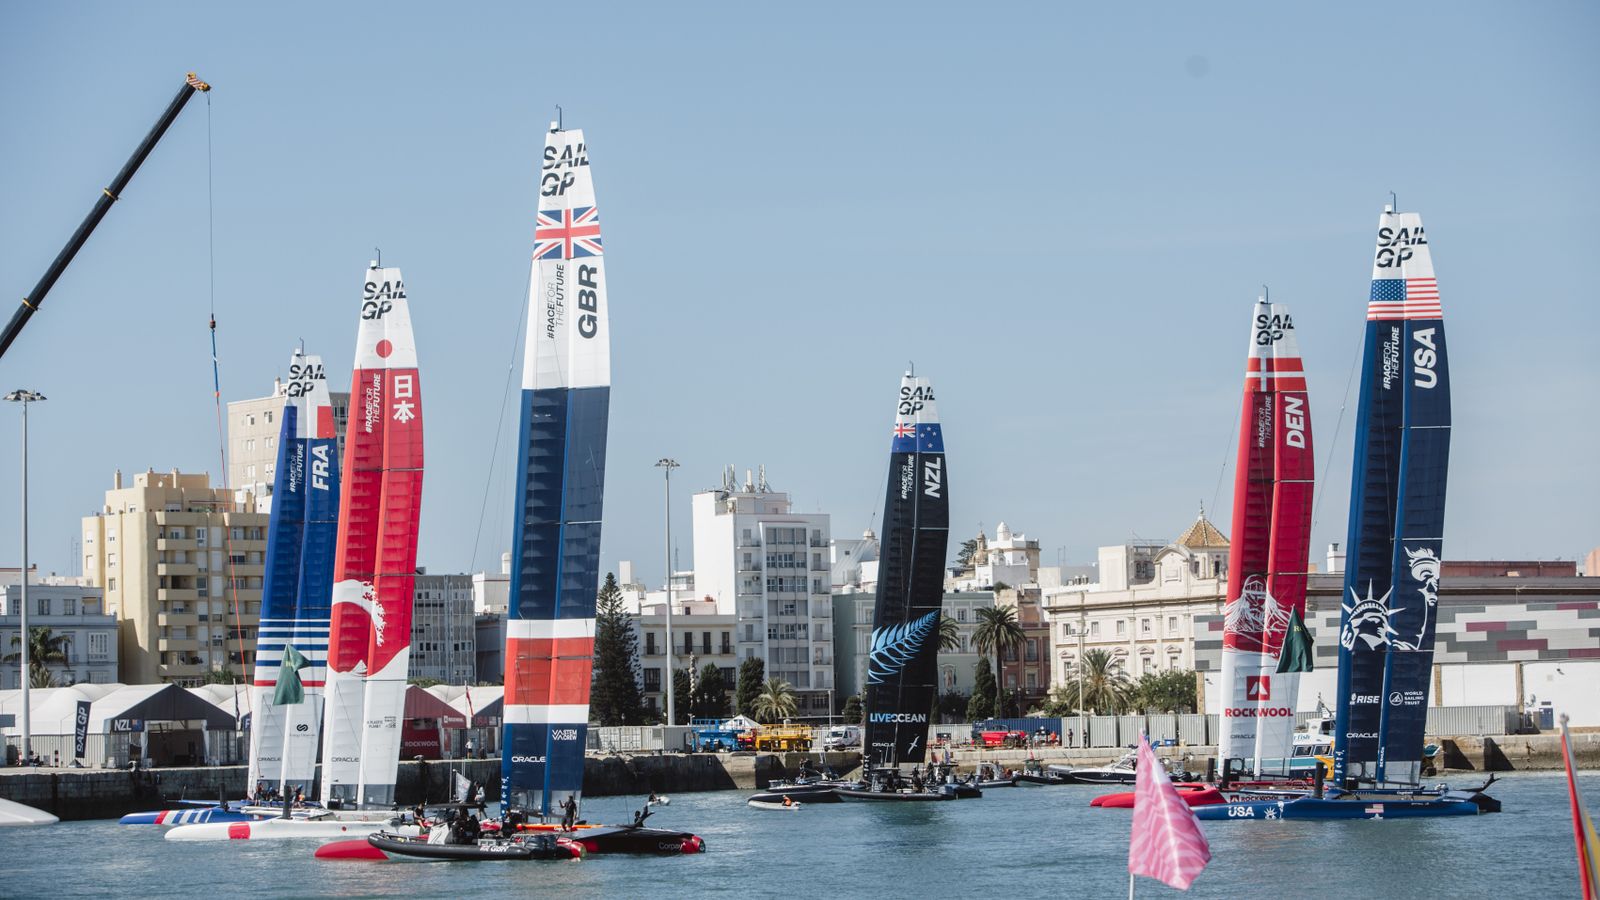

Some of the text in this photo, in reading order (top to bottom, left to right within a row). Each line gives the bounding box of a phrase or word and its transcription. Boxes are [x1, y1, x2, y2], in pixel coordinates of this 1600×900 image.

[542, 143, 589, 170] SAIL
[541, 172, 575, 196] GP
[1377, 227, 1427, 247] SAIL
[1376, 248, 1413, 268] GP
[364, 280, 406, 300] SAIL
[556, 264, 564, 327] THEFUTURE
[362, 300, 392, 320] GP
[547, 282, 556, 339] #RACEFOR
[578, 264, 598, 339] GBR
[1256, 314, 1294, 330] SAIL
[1256, 330, 1284, 346] GP
[1391, 326, 1399, 380] THEFUTURE
[1413, 328, 1437, 389] USA
[289, 364, 326, 380] SAIL
[288, 382, 314, 397] GP
[393, 375, 415, 424] 日本
[900, 386, 935, 401] SAIL
[898, 401, 924, 415] GP
[1285, 396, 1305, 449] DEN
[295, 444, 303, 484] THEFUTURE
[312, 444, 329, 491] FRA
[925, 457, 940, 498] NZL
[1356, 696, 1380, 704] RISE
[1225, 708, 1293, 717] ROCKWOOL
[77, 707, 88, 752] SAIL GP
[114, 720, 132, 731] NZL
[1228, 806, 1254, 817] USA
[658, 842, 683, 851] Corpay
